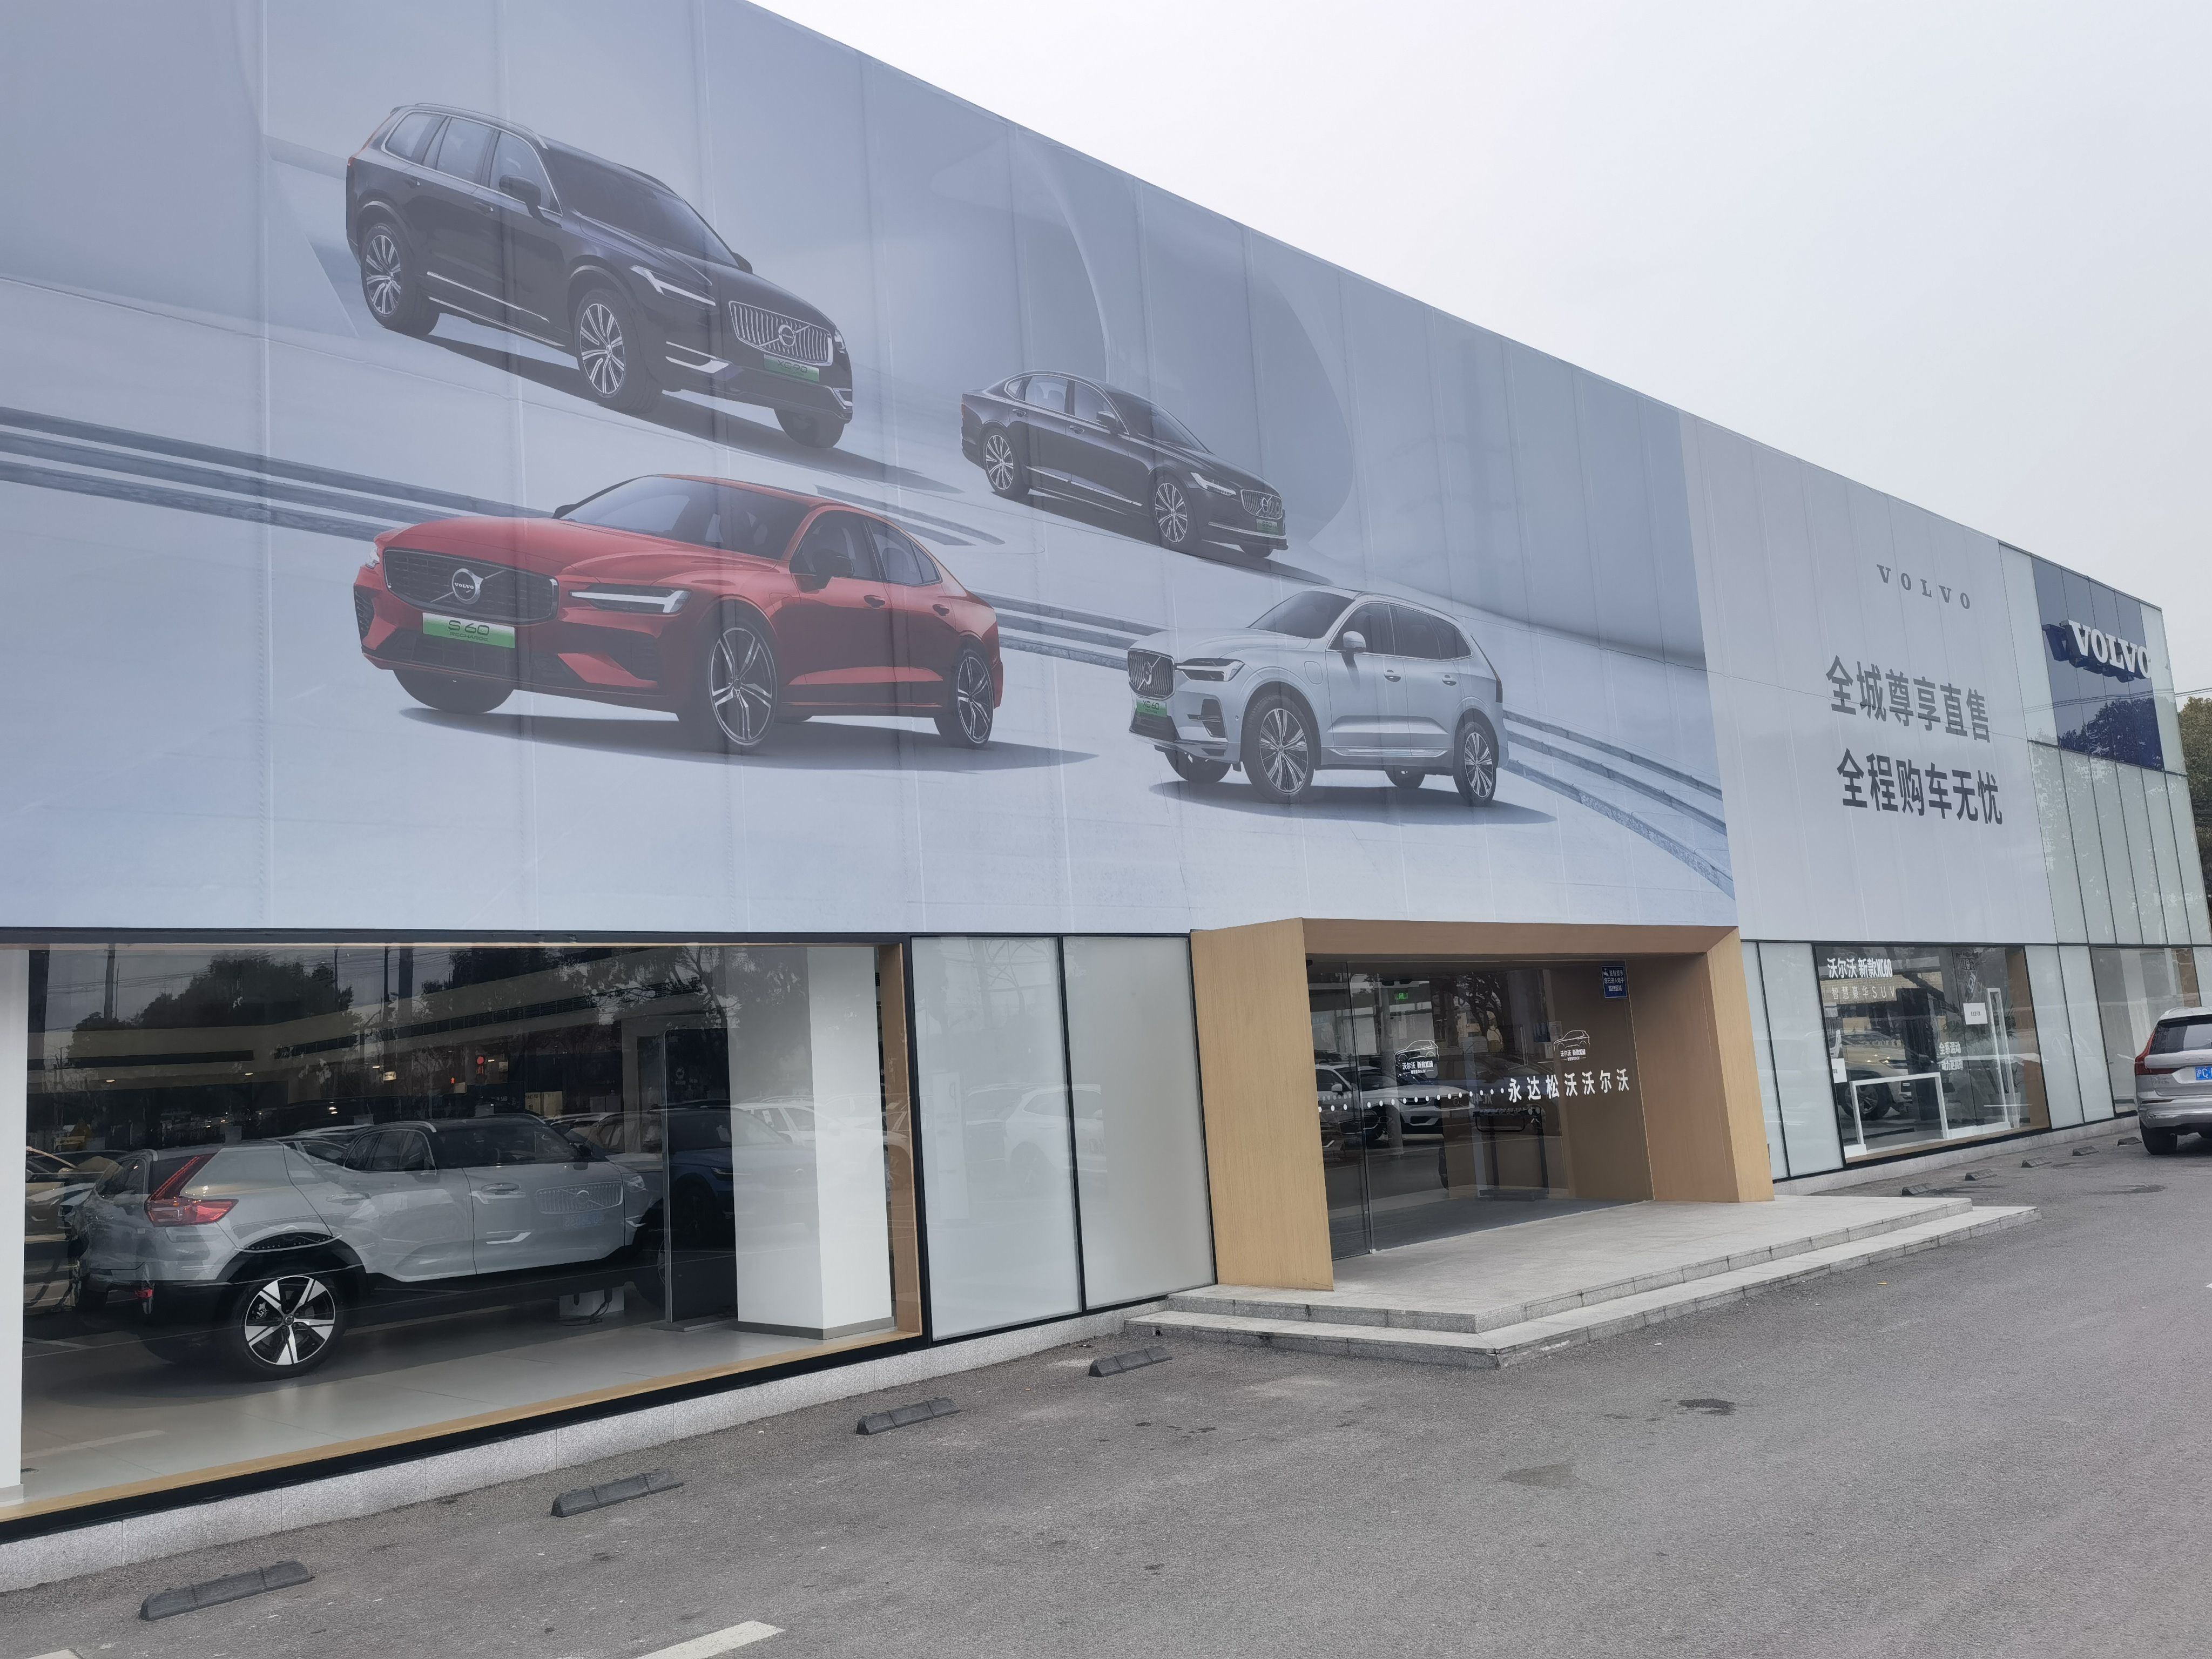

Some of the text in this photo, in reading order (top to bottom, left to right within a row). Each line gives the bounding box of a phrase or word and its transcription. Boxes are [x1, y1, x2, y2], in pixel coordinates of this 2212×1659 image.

[1876, 564, 1970, 610] VOLVO
[2067, 619, 2152, 679] VOLVO
[1825, 655, 1991, 744] 全城尊享直售
[1837, 747, 2003, 825] 全程购车无忧
[1827, 957, 1858, 979] 沃尔沃
[1402, 1062, 1416, 1070] 沃尔沃
[1508, 1068, 1630, 1103] 永达松沃沃尔沃
